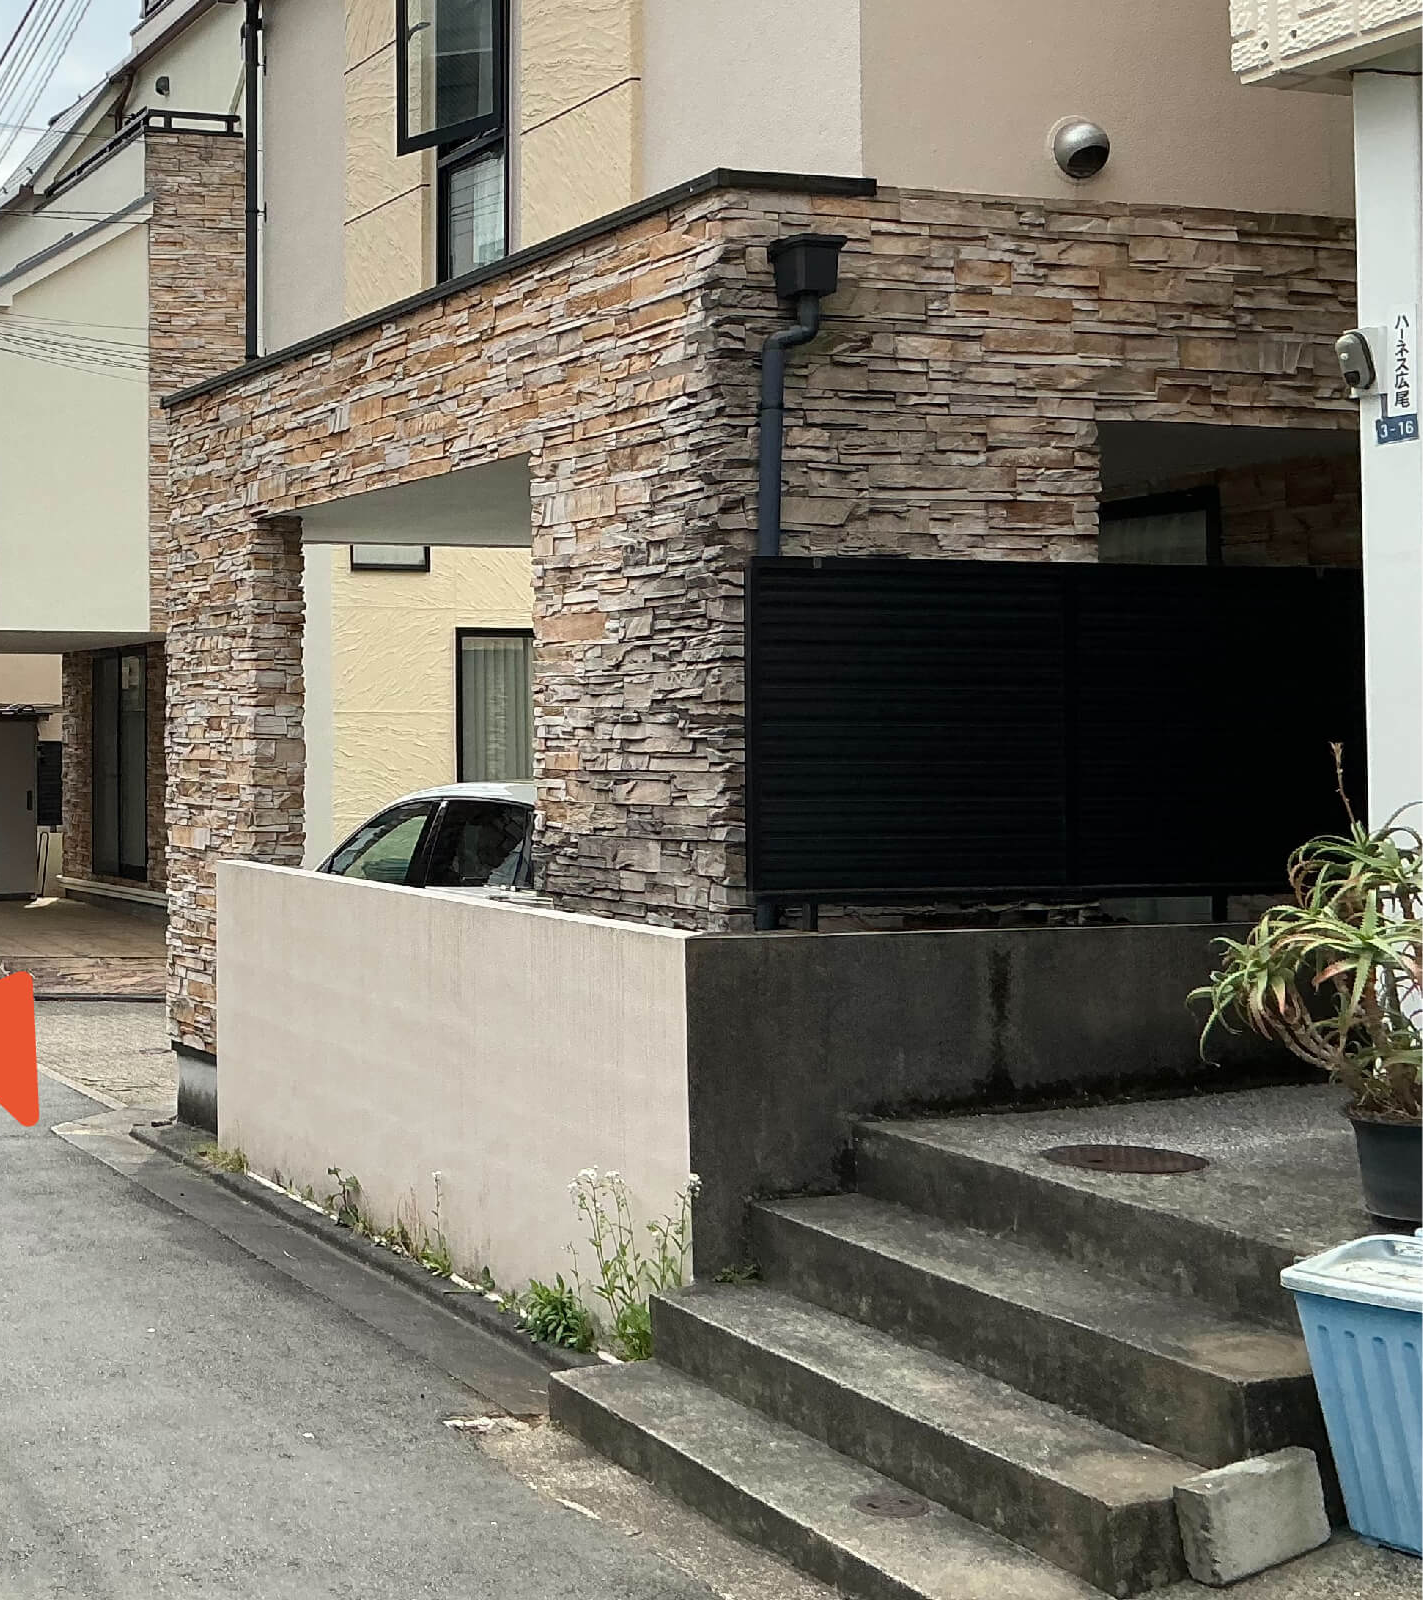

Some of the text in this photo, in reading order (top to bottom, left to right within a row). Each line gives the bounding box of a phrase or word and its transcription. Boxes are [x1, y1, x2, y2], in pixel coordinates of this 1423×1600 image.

[1394, 315, 1410, 408] ハーネス広尾
[1380, 421, 1414, 438] 3-16
